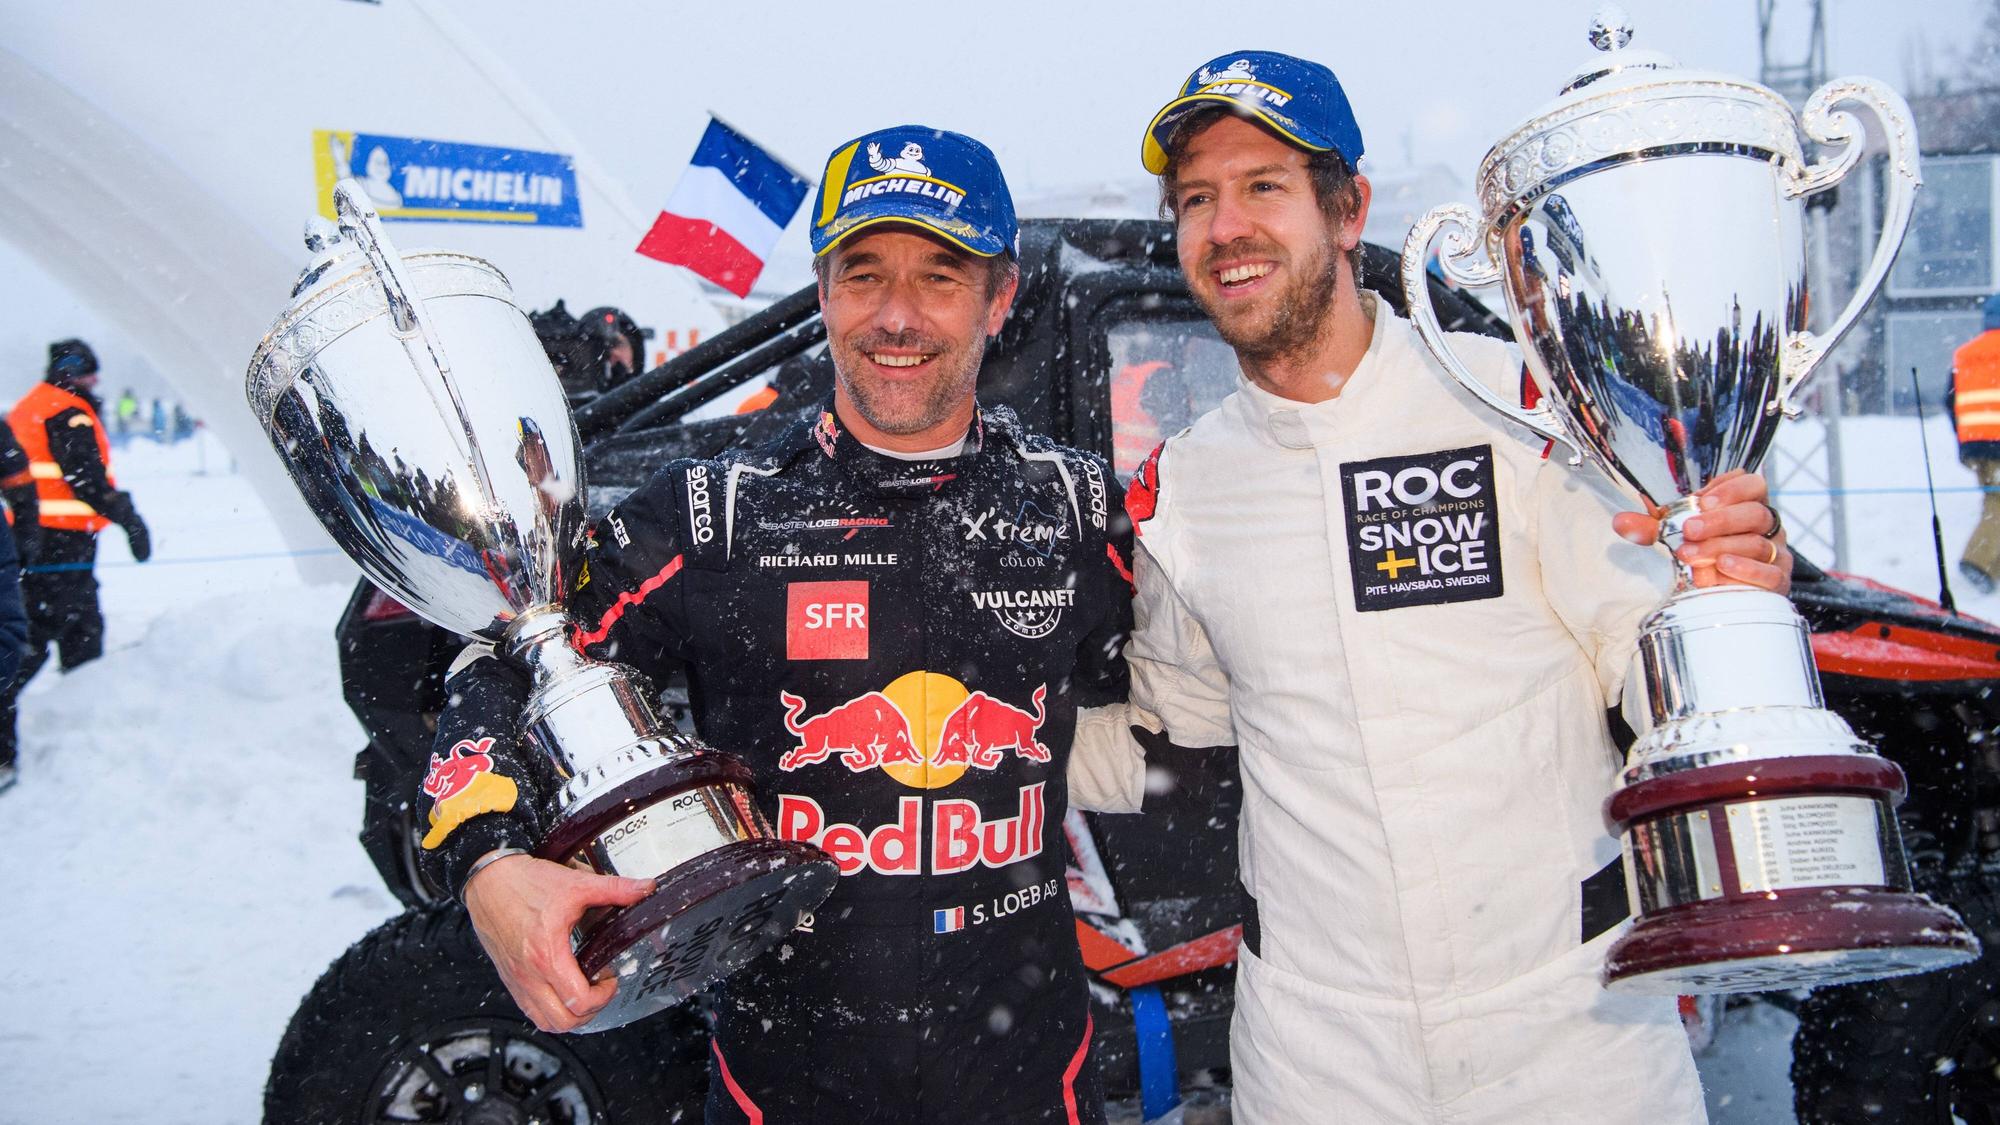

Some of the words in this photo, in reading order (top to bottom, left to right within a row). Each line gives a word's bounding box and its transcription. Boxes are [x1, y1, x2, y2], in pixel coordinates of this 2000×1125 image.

[403, 165, 562, 206] MICHELIN
[842, 178, 964, 208] MICHELIN
[1354, 460, 1482, 511] ROC
[686, 465, 714, 546] sparco
[1356, 512, 1387, 523] RACE
[1392, 509, 1408, 518] OF
[1412, 500, 1485, 517] CHAMPIONS
[1359, 512, 1484, 551] SNOW
[759, 554, 838, 567] RICHARD
[844, 553, 898, 565] MILLE
[1000, 557, 1046, 568] COLOR
[1365, 584, 1387, 595] PITE
[1389, 579, 1444, 593] HAVSBAD,
[1445, 574, 1490, 587] SWEDEN
[970, 589, 1075, 610] VULCANET
[805, 603, 866, 629] SFR
[1005, 617, 1056, 636] company
[603, 821, 635, 848] ROC
[777, 793, 923, 877] Red
[932, 780, 1047, 876] Bull
[972, 903, 989, 925] S.
[993, 885, 1041, 918] LOEB
